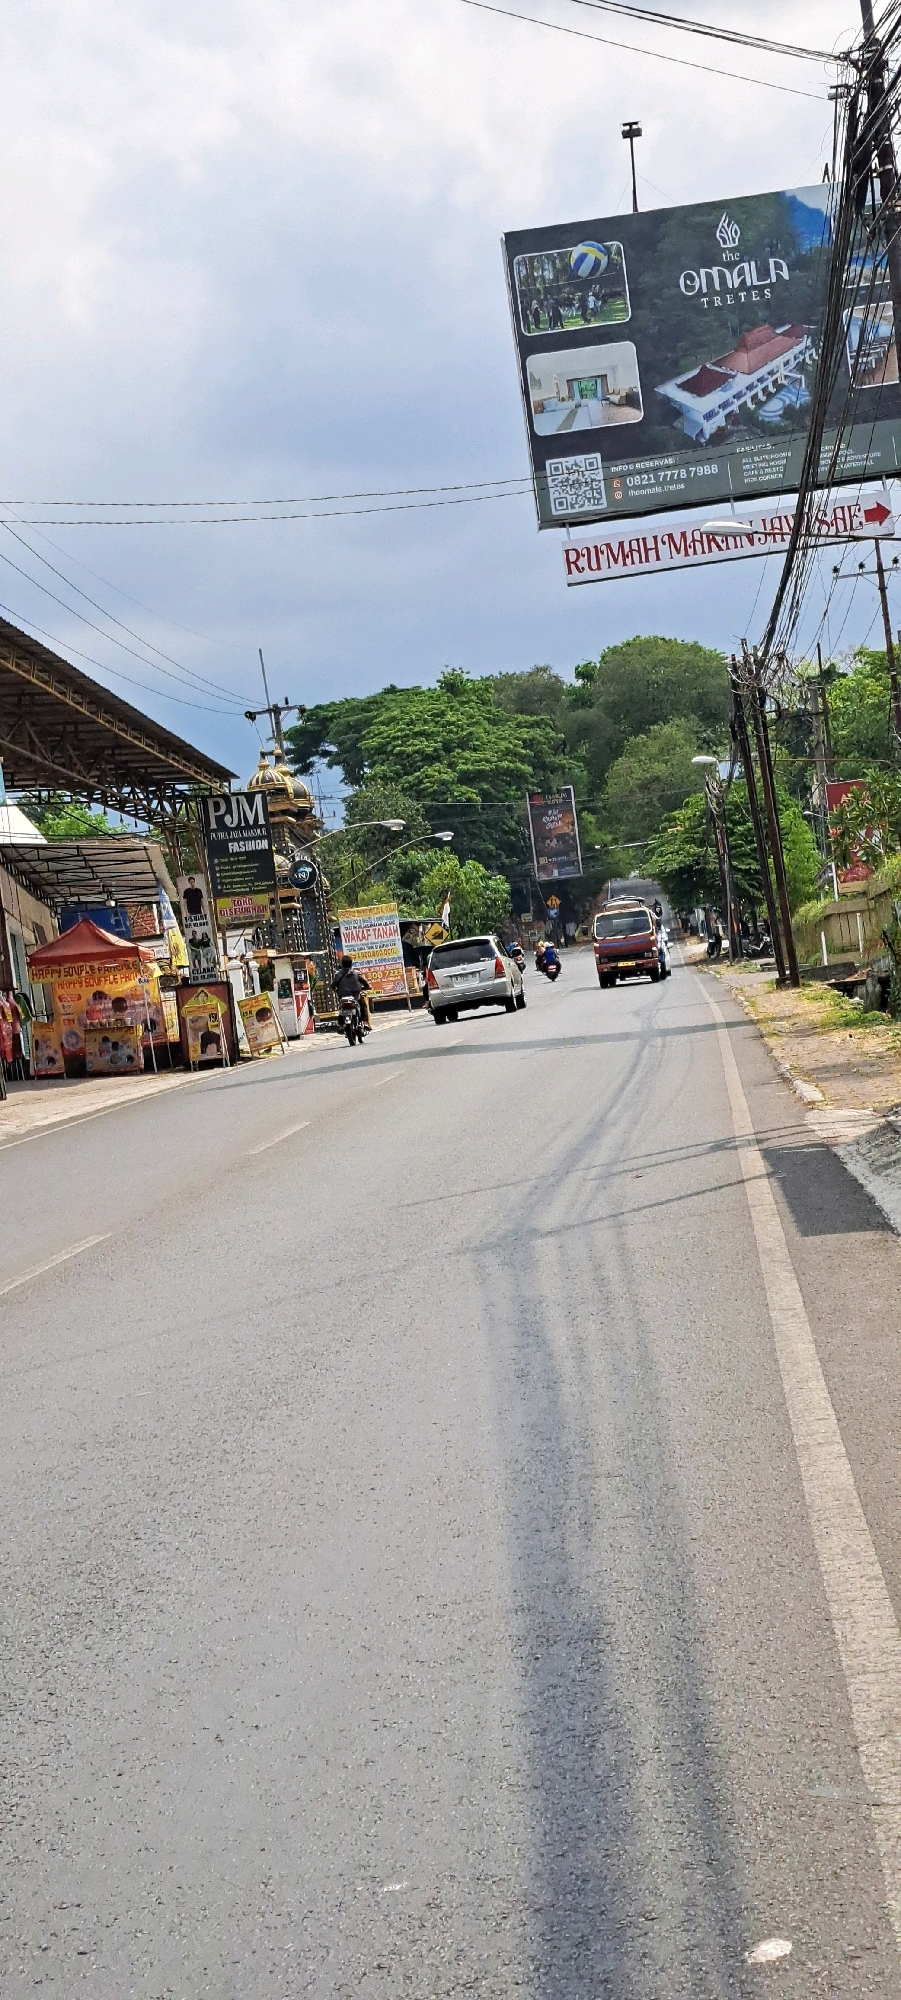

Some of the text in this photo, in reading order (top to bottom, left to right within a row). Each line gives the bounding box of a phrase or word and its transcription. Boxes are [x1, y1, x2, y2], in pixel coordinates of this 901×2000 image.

[722, 250, 740, 262] the
[679, 258, 790, 296] OMALA
[700, 288, 772, 309] TRETES
[611, 464, 628, 473] INFO
[635, 457, 676, 469] RESERVASI
[626, 464, 718, 487] 0821 7778 7988
[563, 536, 662, 576] RUMAH
[206, 793, 266, 830] PJM
[210, 831, 229, 841] PUTRA
[229, 830, 243, 840] JAYA
[228, 839, 269, 853] FASHION
[232, 898, 253, 907] TOKO
[342, 928, 371, 944] WAKAF
[372, 925, 399, 940] TANAH
[31, 966, 61, 980] HAPPY
[57, 978, 83, 990] HAPPY
